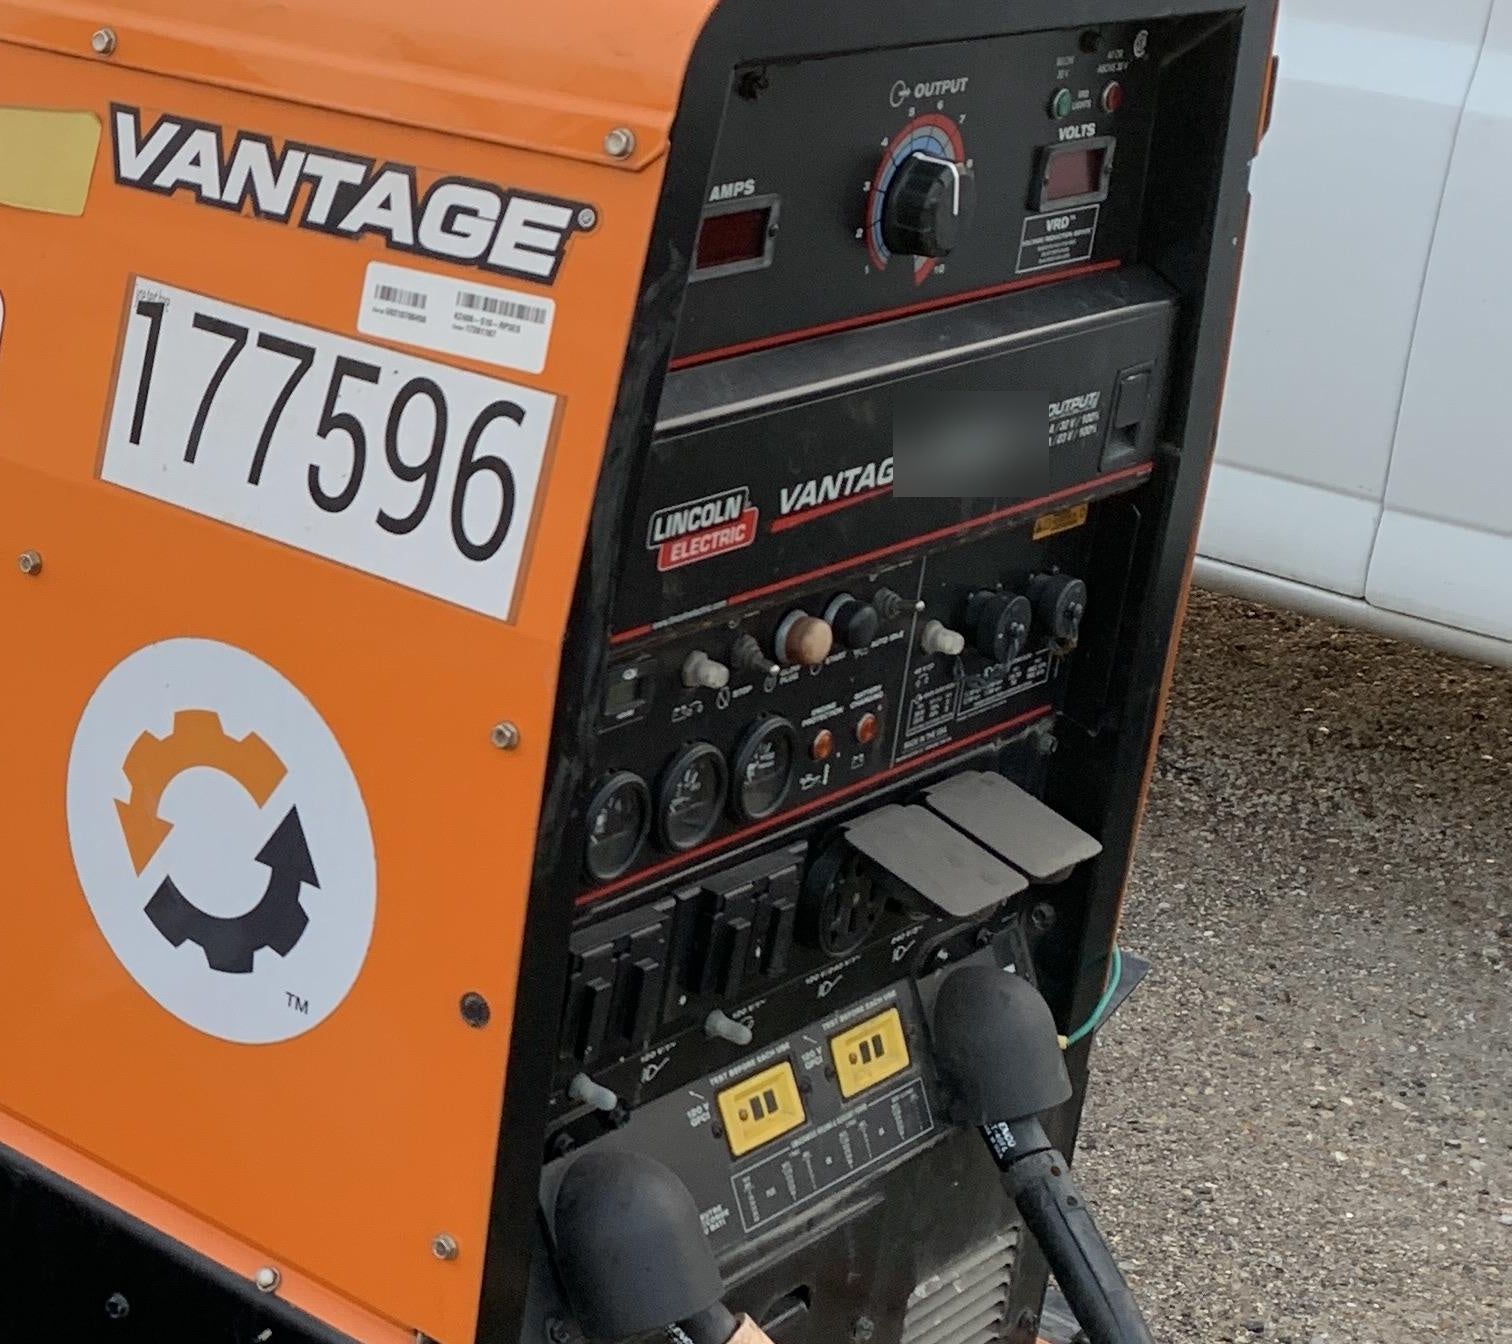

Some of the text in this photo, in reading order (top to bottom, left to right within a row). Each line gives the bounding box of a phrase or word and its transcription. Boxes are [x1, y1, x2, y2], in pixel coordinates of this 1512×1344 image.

[914, 77, 969, 98] OUTPUT
[1058, 122, 1096, 141] VOLTS
[113, 106, 574, 280] VANTAGE
[709, 178, 756, 204] AMPS
[1045, 215, 1070, 232] VRD
[128, 300, 527, 562] 177596
[779, 456, 894, 514] VANTAG
[653, 494, 743, 542] LINCOLN
[670, 522, 747, 561] ELECTRIC
[709, 1071, 728, 1086] TEST
